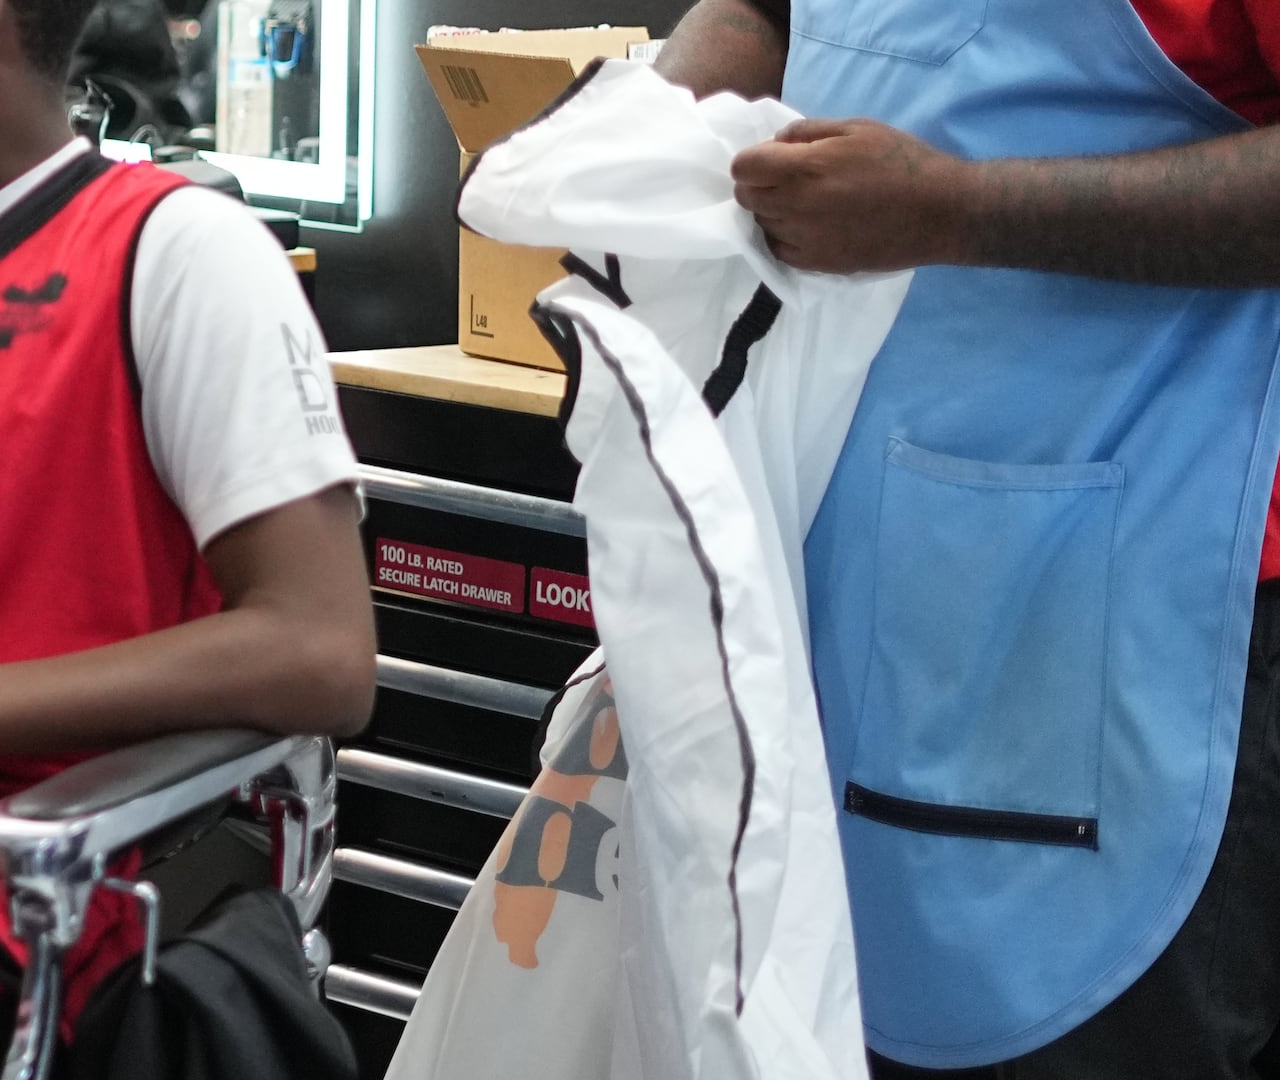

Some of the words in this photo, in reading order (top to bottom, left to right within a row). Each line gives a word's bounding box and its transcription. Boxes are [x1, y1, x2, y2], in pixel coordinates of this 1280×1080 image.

[381, 544, 406, 564] 100
[407, 552, 424, 569] LB.
[426, 556, 464, 576] RATED
[379, 566, 420, 587] SECURE
[423, 576, 458, 595] LATCH
[461, 583, 512, 606] DRAWER
[536, 580, 591, 612] LOOK
